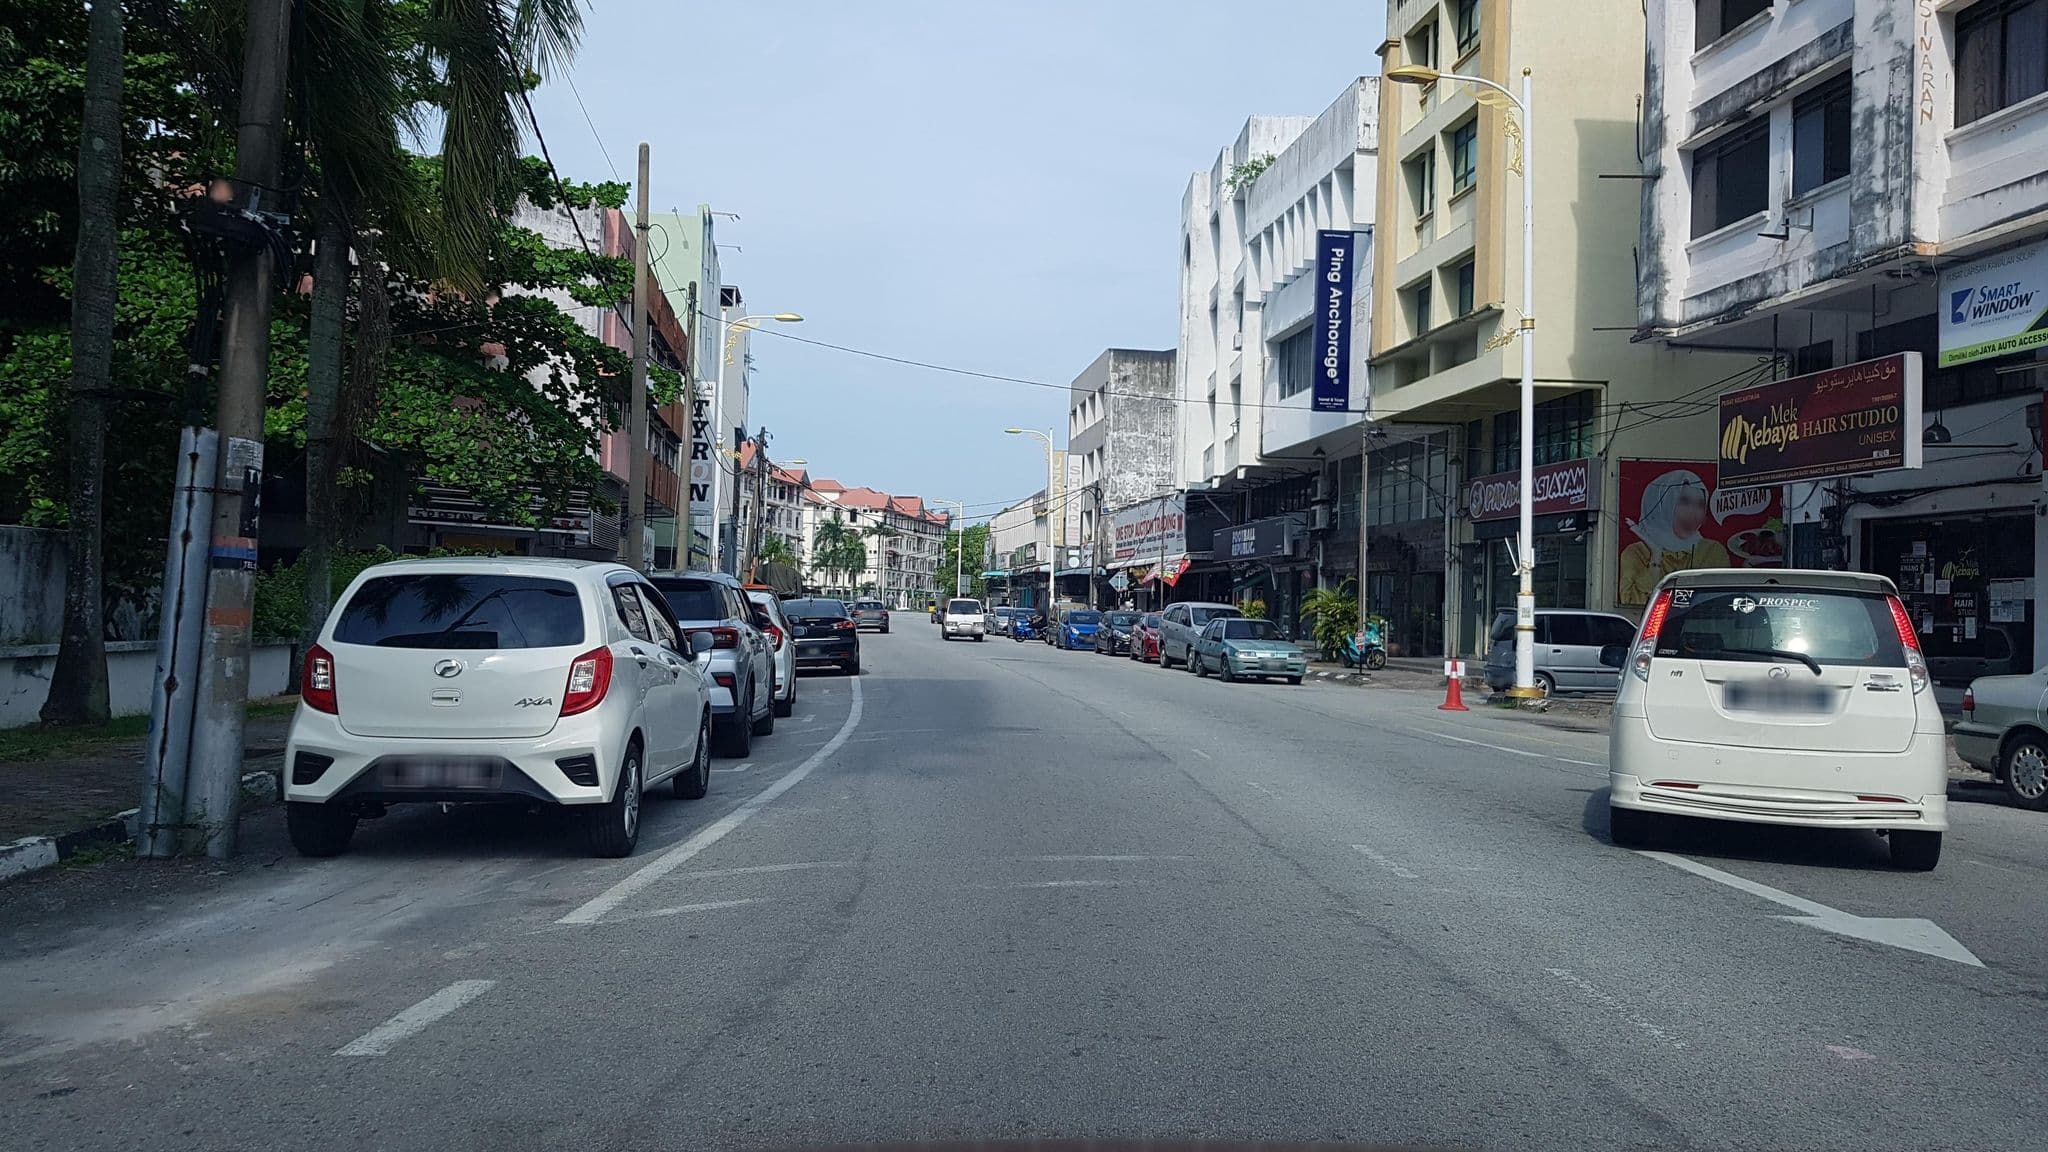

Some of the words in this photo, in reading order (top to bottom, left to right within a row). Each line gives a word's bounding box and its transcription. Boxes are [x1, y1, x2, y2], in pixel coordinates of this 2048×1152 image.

[1919, 0, 1935, 126] SINARAN
[1327, 248, 1345, 283] Ping
[1972, 291, 2034, 320] WINDOW
[1979, 344, 1997, 355] JAYA
[1998, 339, 2017, 351] AUTO
[2018, 331, 2048, 347] ACCESS
[1769, 398, 1799, 426] Mek
[1801, 418, 1837, 438] HAIR
[1839, 405, 1899, 432] STUDIO
[1858, 429, 1897, 446] UNISEX
[1549, 467, 1587, 500] AYAM
[1716, 494, 1738, 514] NASI
[1741, 488, 1767, 507] AYAM
[1759, 597, 1816, 609] PROSPEC
[1953, 599, 1974, 608] HAIR
[514, 697, 553, 708] AXIA
